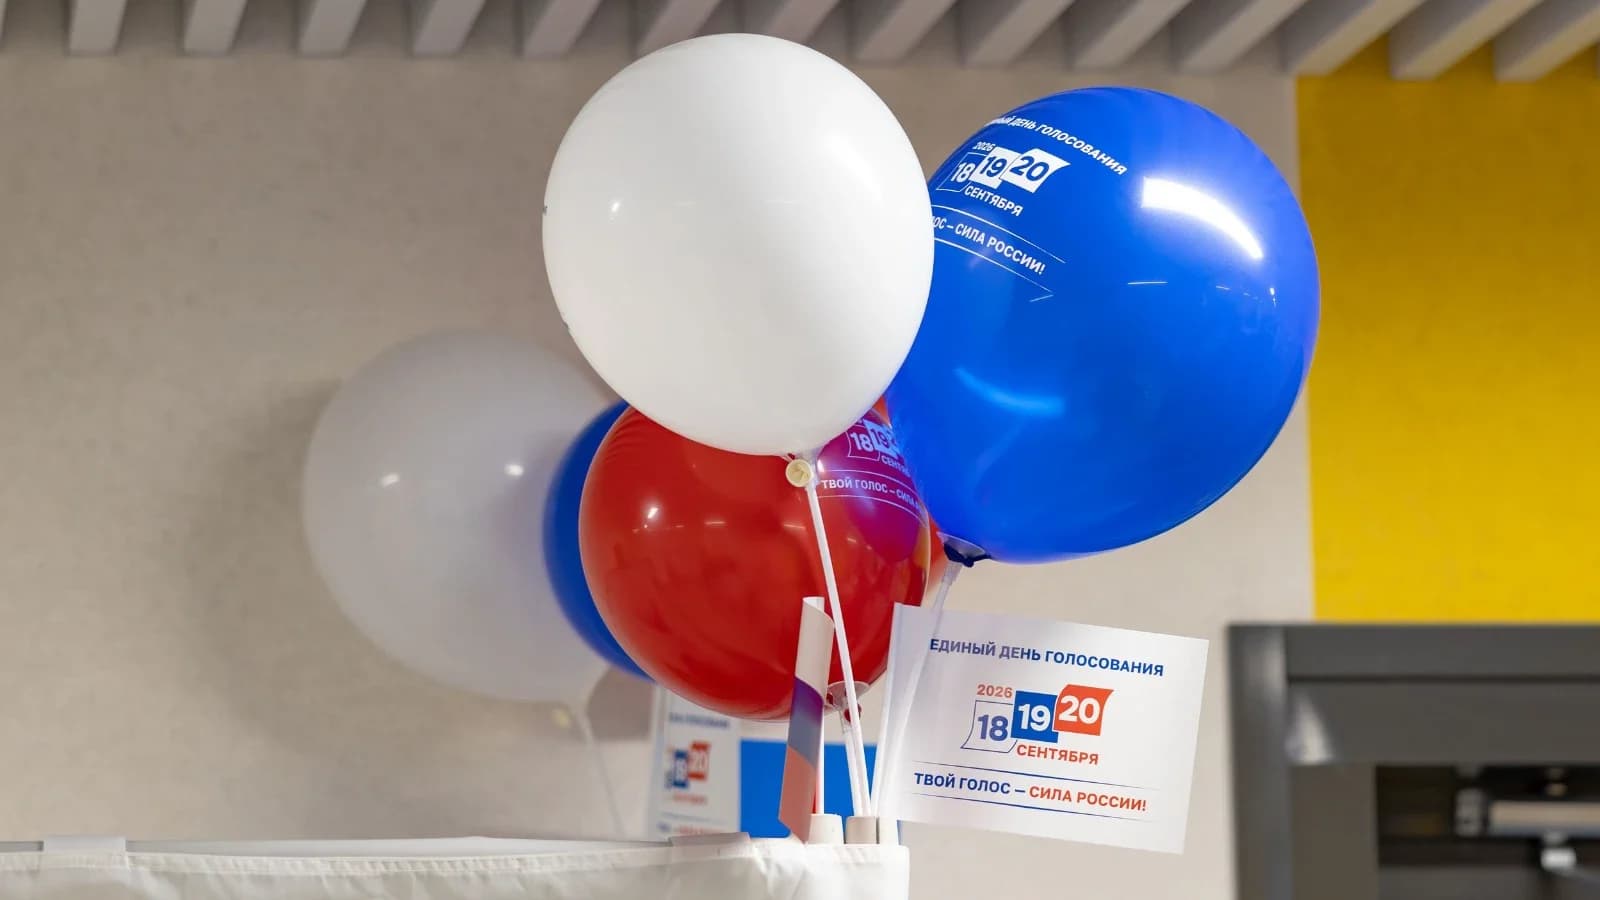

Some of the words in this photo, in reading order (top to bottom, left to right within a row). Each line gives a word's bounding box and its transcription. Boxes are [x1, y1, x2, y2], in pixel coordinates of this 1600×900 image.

[972, 141, 996, 152] 2026
[1008, 118, 1036, 130] ДЕНЬ
[1035, 124, 1128, 176] ГОЛОСОВАНИЯ
[951, 162, 976, 183] 18
[979, 156, 1008, 177] 19
[1010, 155, 1050, 182] 20
[964, 185, 1024, 217] СЕНТЯБРЯ
[955, 223, 986, 245] СИЛА
[986, 236, 1046, 275] РОССИИ!
[850, 432, 874, 452] 18
[822, 476, 853, 489] ТВОЙ
[855, 480, 888, 494] ГОЛОС
[930, 638, 996, 657] ЕДИНЫЙ
[999, 646, 1041, 662] ДЕНЬ
[1045, 650, 1164, 677] ГОЛОСОВАНИЯ
[977, 684, 1013, 699] 2026
[977, 714, 1008, 741] 18
[1018, 703, 1050, 732] 19
[1058, 695, 1100, 725] 20
[1016, 744, 1099, 766] СЕНТЯБРЯ
[914, 772, 955, 789] ТВОЙ
[959, 777, 1011, 795] ГОЛОС
[1029, 785, 1072, 803] СИЛА
[1076, 792, 1147, 812] РОССИИ!
